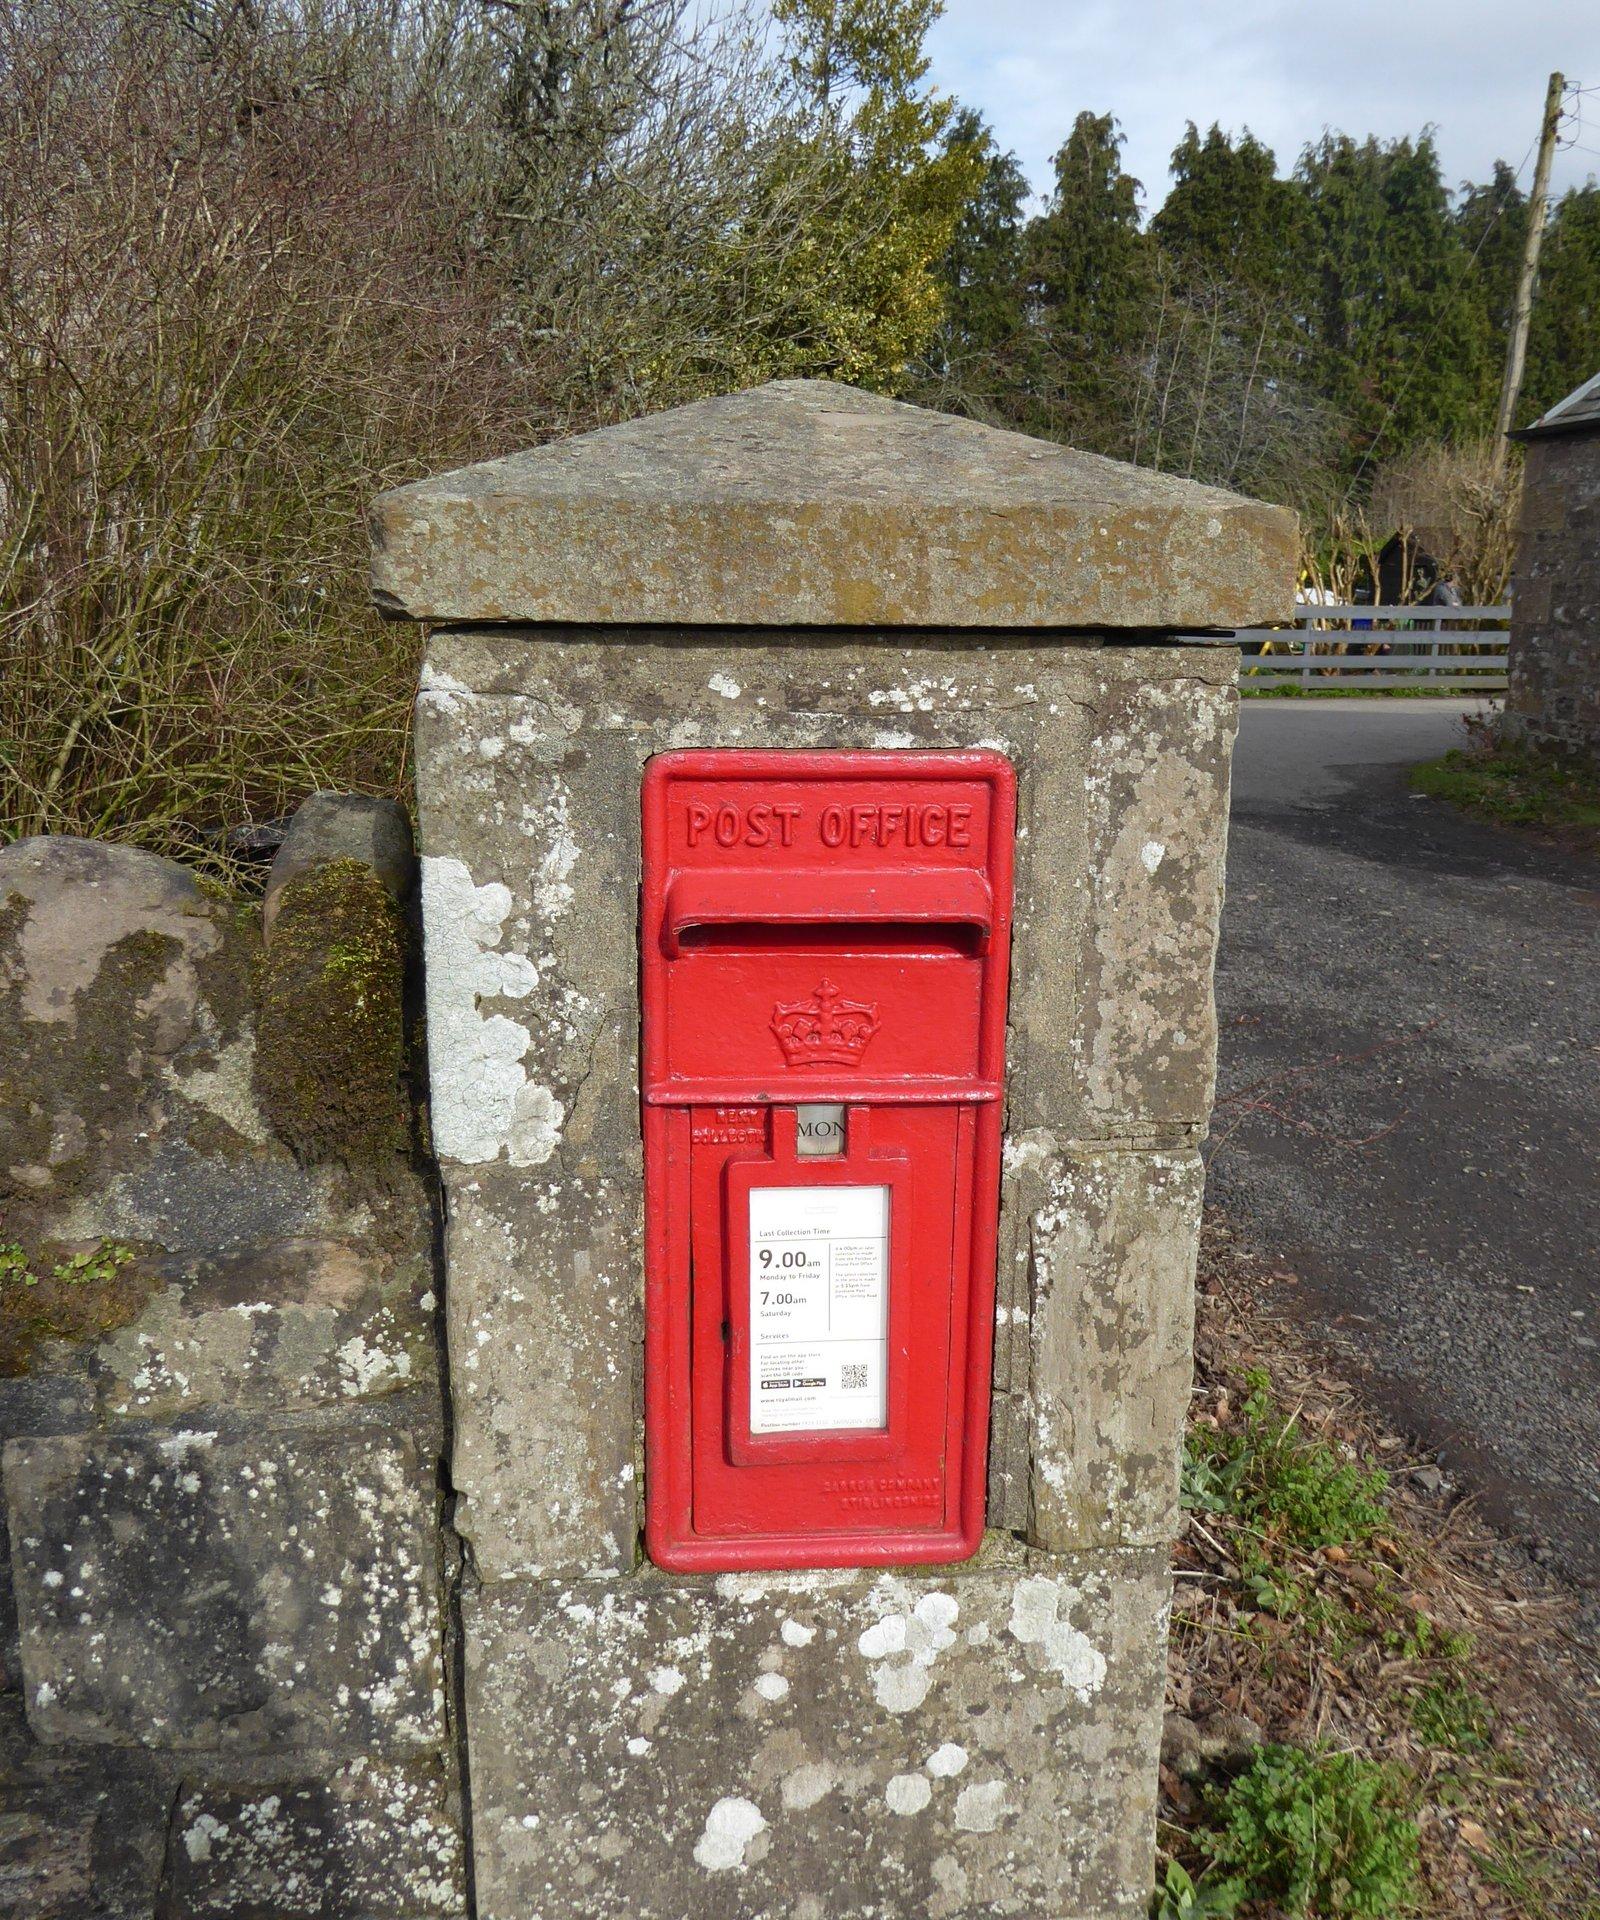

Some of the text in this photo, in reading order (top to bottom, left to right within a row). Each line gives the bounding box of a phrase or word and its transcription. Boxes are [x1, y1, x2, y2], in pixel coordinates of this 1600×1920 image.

[686, 802, 971, 848] POST OFFICE
[798, 1121, 846, 1137] MON
[776, 1228, 811, 1237] Collection
[759, 1249, 821, 1269] 9.00am
[798, 1272, 821, 1280] Friday
[760, 1291, 807, 1305] 7.00am
[760, 1310, 792, 1318] Saturday
